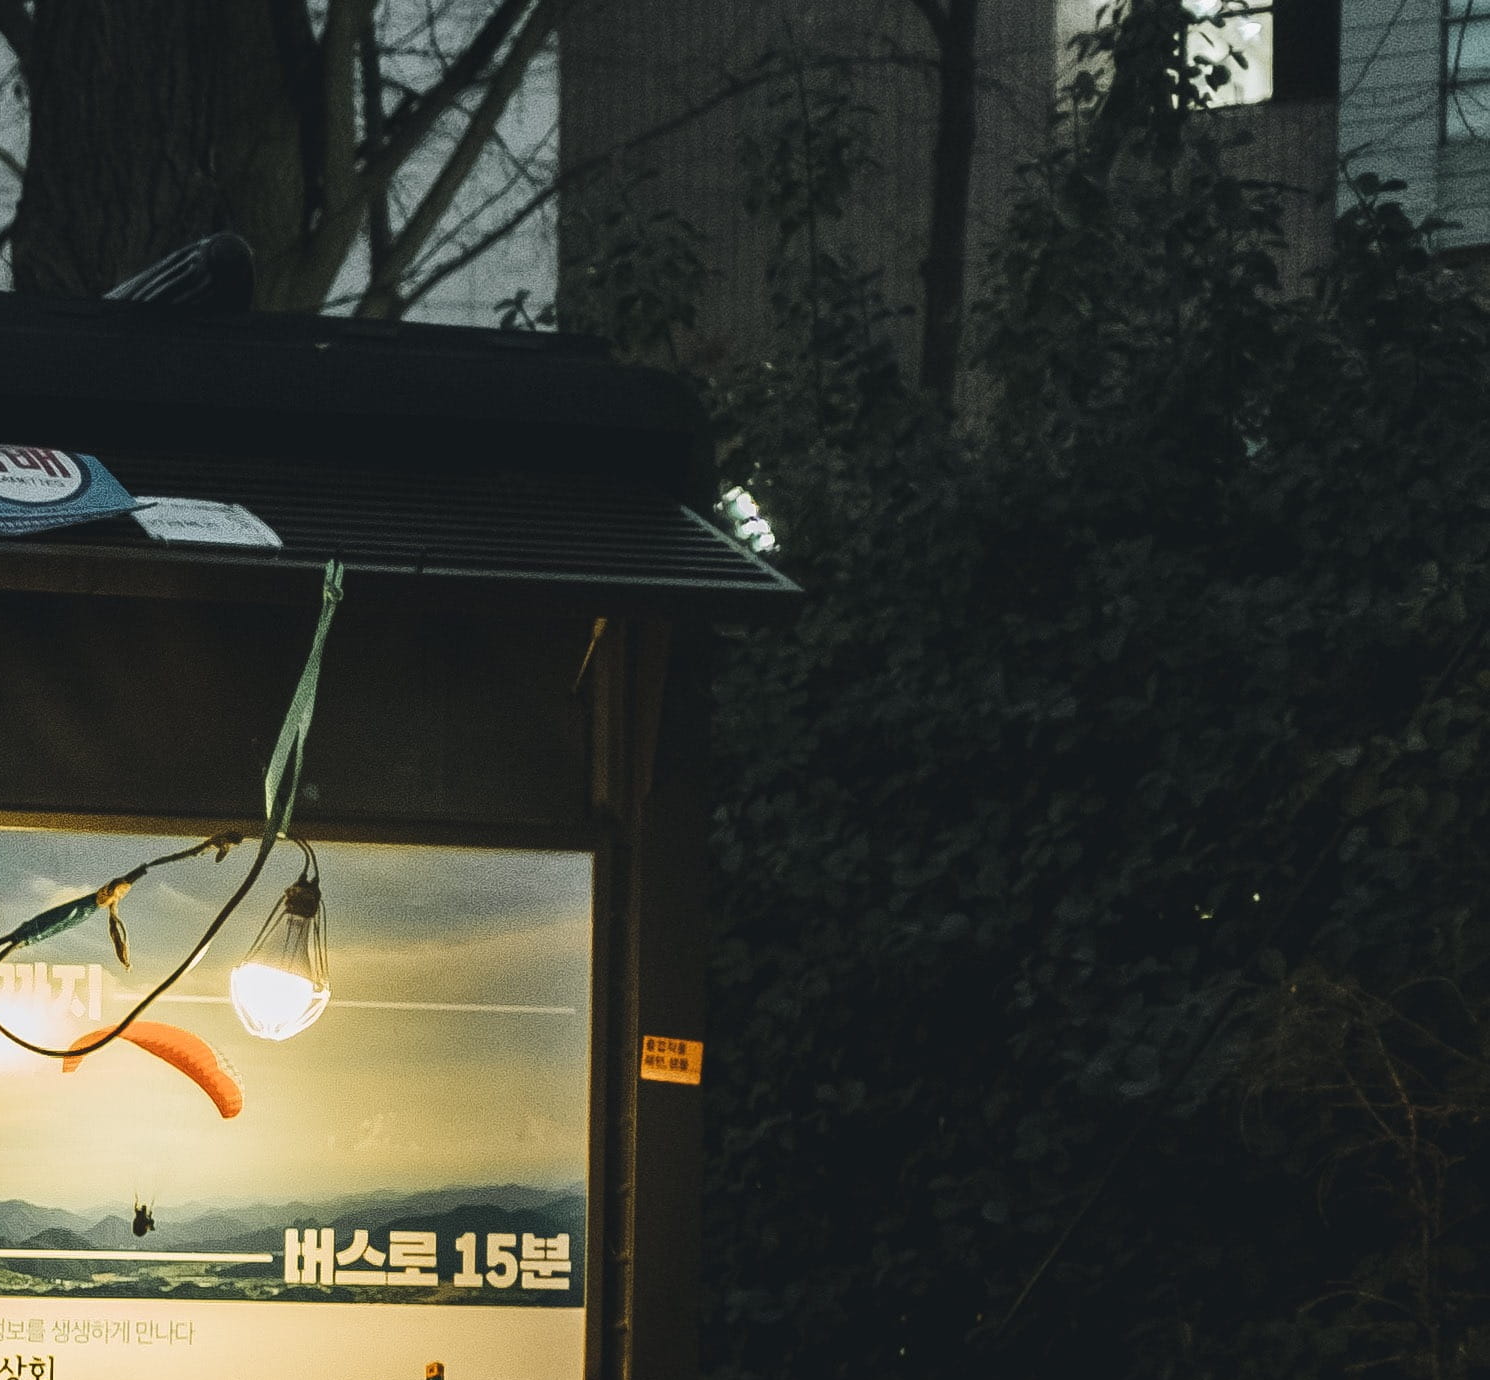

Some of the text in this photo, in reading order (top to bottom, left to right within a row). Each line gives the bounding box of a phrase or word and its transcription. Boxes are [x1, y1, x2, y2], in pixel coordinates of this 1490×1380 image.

[284, 1227, 572, 1291] 버스로 15분
[51, 1318, 131, 1345] 생생하게
[135, 1319, 197, 1346] 만나다
